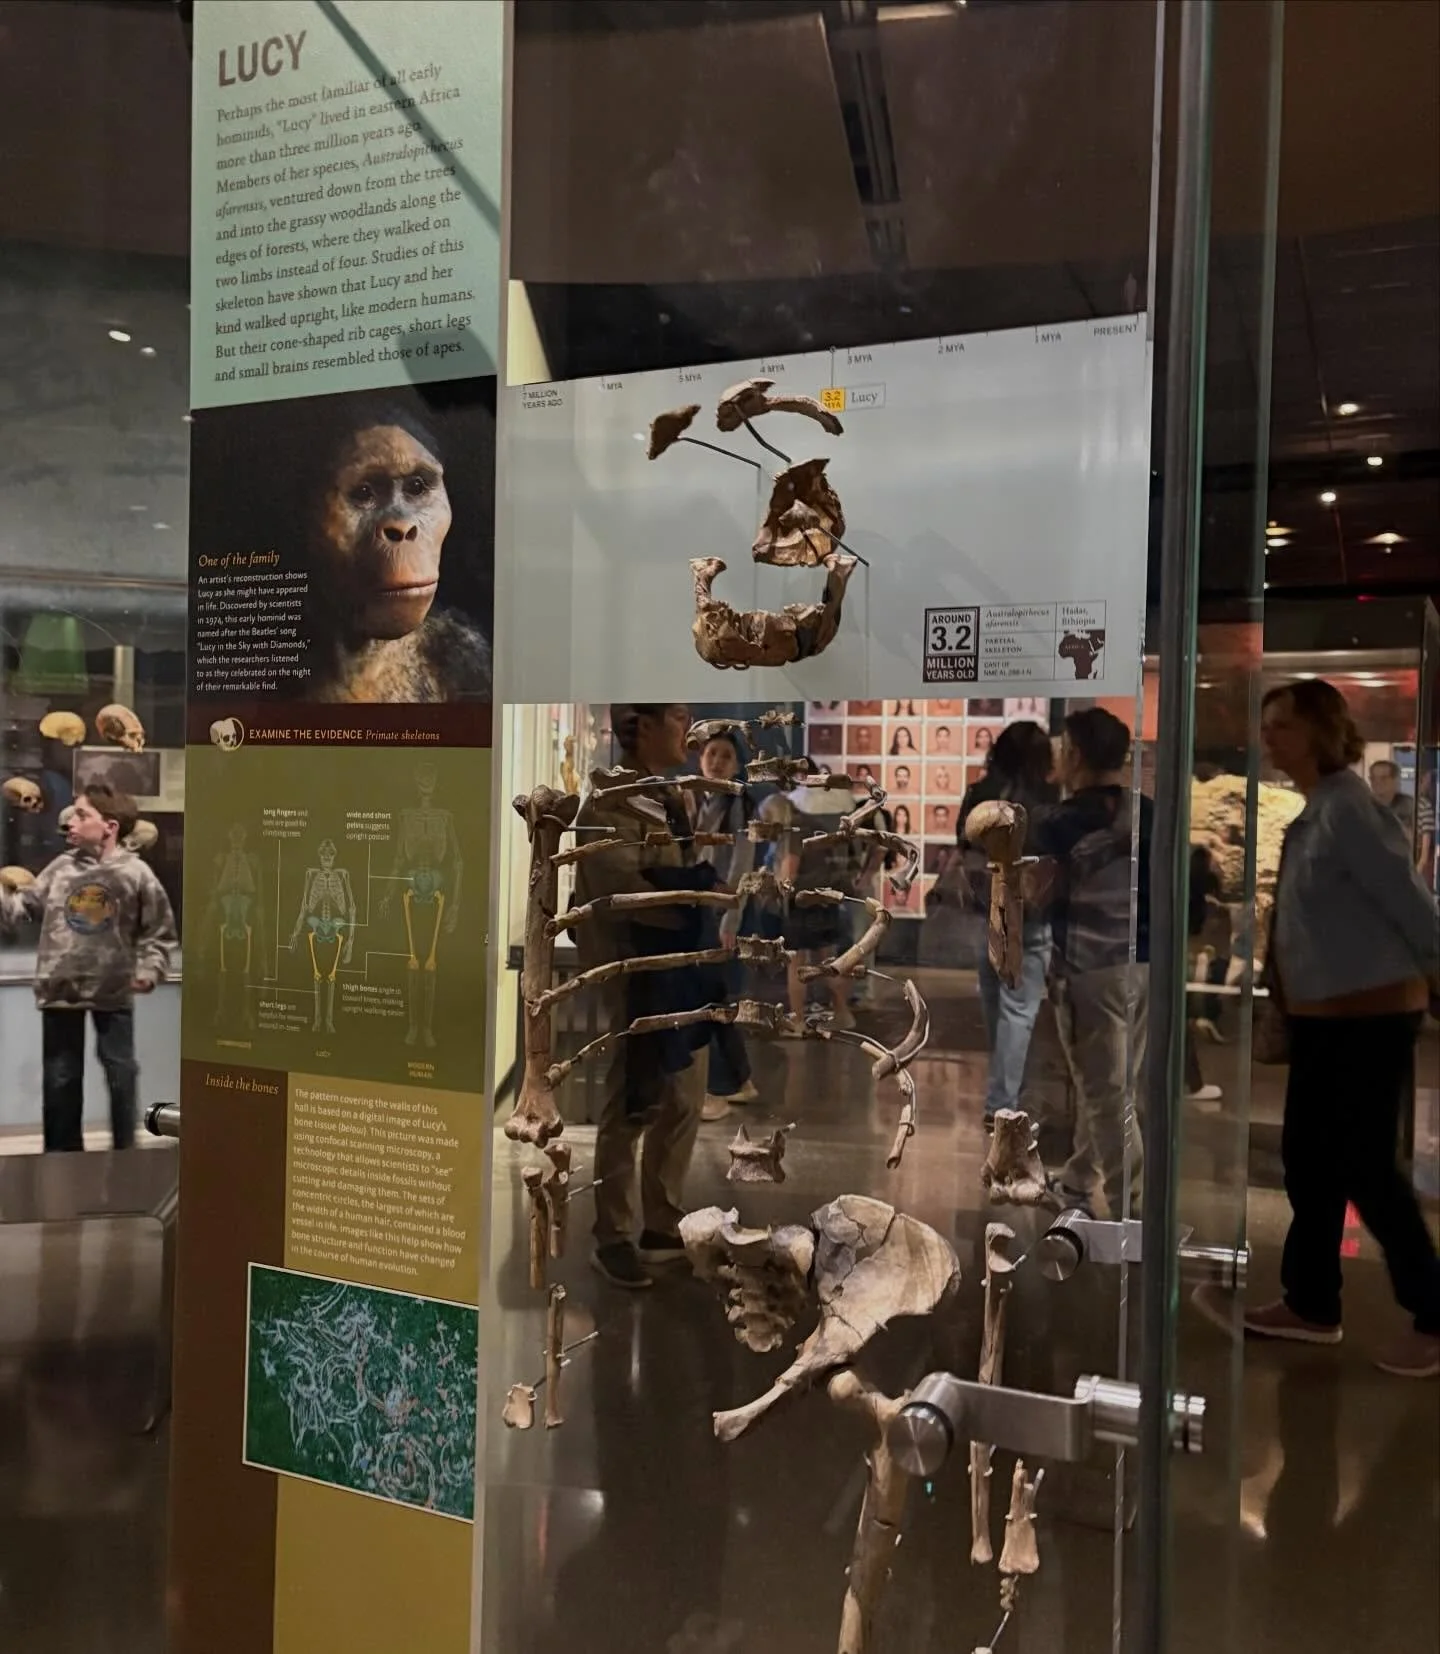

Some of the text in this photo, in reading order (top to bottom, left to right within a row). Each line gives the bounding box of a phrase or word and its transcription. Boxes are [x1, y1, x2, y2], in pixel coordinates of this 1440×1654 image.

[218, 30, 307, 86] LUCY
[217, 104, 262, 122] Perhaps
[266, 97, 285, 112] the
[288, 91, 318, 107] most
[321, 82, 370, 101] familiar
[409, 65, 442, 83] early
[320, 106, 351, 125] lived
[353, 106, 366, 118] in
[369, 99, 415, 115] eastern
[419, 89, 460, 105] Africa
[216, 188, 461, 239] and into the grassy woodlands along the
[216, 265, 453, 311] skeleton have shown that Lucy and her
[216, 290, 475, 334] kind walked upright, like modern humans.
[216, 313, 471, 357] But their cone-shaped rib cages, short legs
[1094, 324, 1138, 336] PRESENT
[1041, 334, 1062, 342] MYA
[946, 344, 965, 353] MYA
[215, 340, 464, 380] and small brains resembled those of apes.
[854, 354, 872, 362] MYA
[768, 364, 784, 372] MYA
[685, 374, 702, 382] MYA
[607, 382, 623, 390] MYA
[529, 390, 558, 399] MILLION
[825, 391, 840, 402] 3.2
[852, 392, 878, 404] Lucy
[523, 398, 562, 409] YEARS AGO
[199, 551, 279, 568] One of the family
[198, 590, 213, 599] Lucy
[224, 588, 235, 596] she
[237, 587, 256, 598] might
[259, 586, 274, 594] have
[276, 584, 308, 596] appeared
[932, 614, 971, 624] AROUND
[198, 628, 219, 637] named
[221, 628, 236, 636] after
[280, 629, 296, 637] song
[932, 626, 970, 651] 3.2
[226, 642, 236, 650] the
[239, 641, 250, 652] Sky
[253, 641, 268, 649] with
[926, 657, 974, 669] MILLION
[926, 670, 974, 680] YEARS OLD
[197, 681, 277, 690] of their remarkable find.
[250, 729, 440, 740] EXAMINE THE EVIDENCE Primate skeletons
[206, 1074, 280, 1095] Inside the bones
[296, 1090, 438, 1114] The pattern covering the walls of this
[295, 1103, 308, 1112] hall
[318, 1106, 339, 1116] based
[359, 1112, 384, 1123] digital
[386, 1116, 410, 1128] image
[412, 1119, 421, 1127] of
